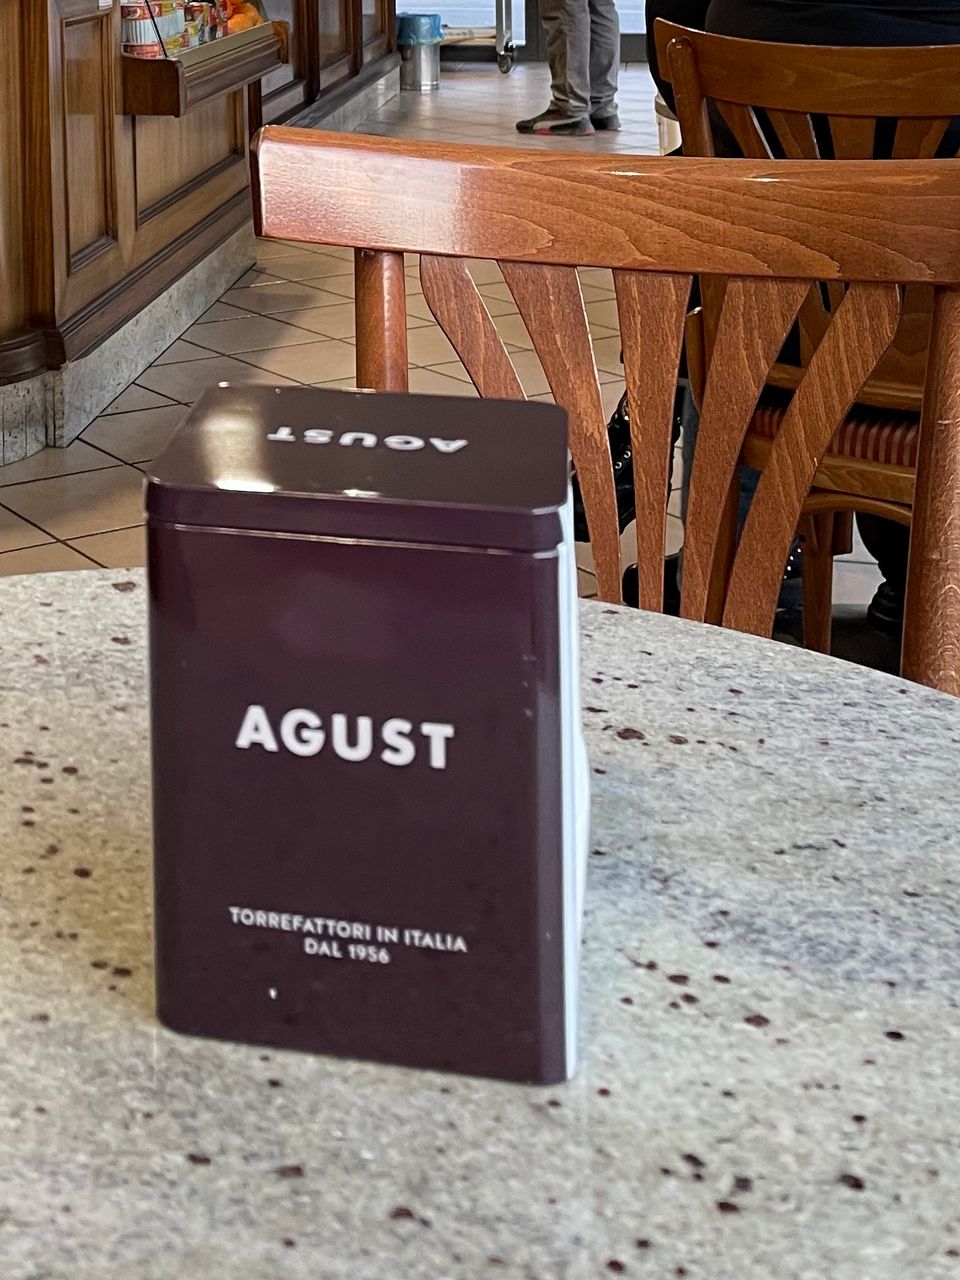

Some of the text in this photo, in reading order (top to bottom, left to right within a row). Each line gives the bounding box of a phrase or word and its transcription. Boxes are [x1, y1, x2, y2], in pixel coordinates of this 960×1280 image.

[267, 426, 469, 454] AGUST
[235, 704, 454, 770] AGUST
[228, 905, 468, 953] TORREFATTORI IN ITALIA
[304, 937, 390, 965] DAL 1956
